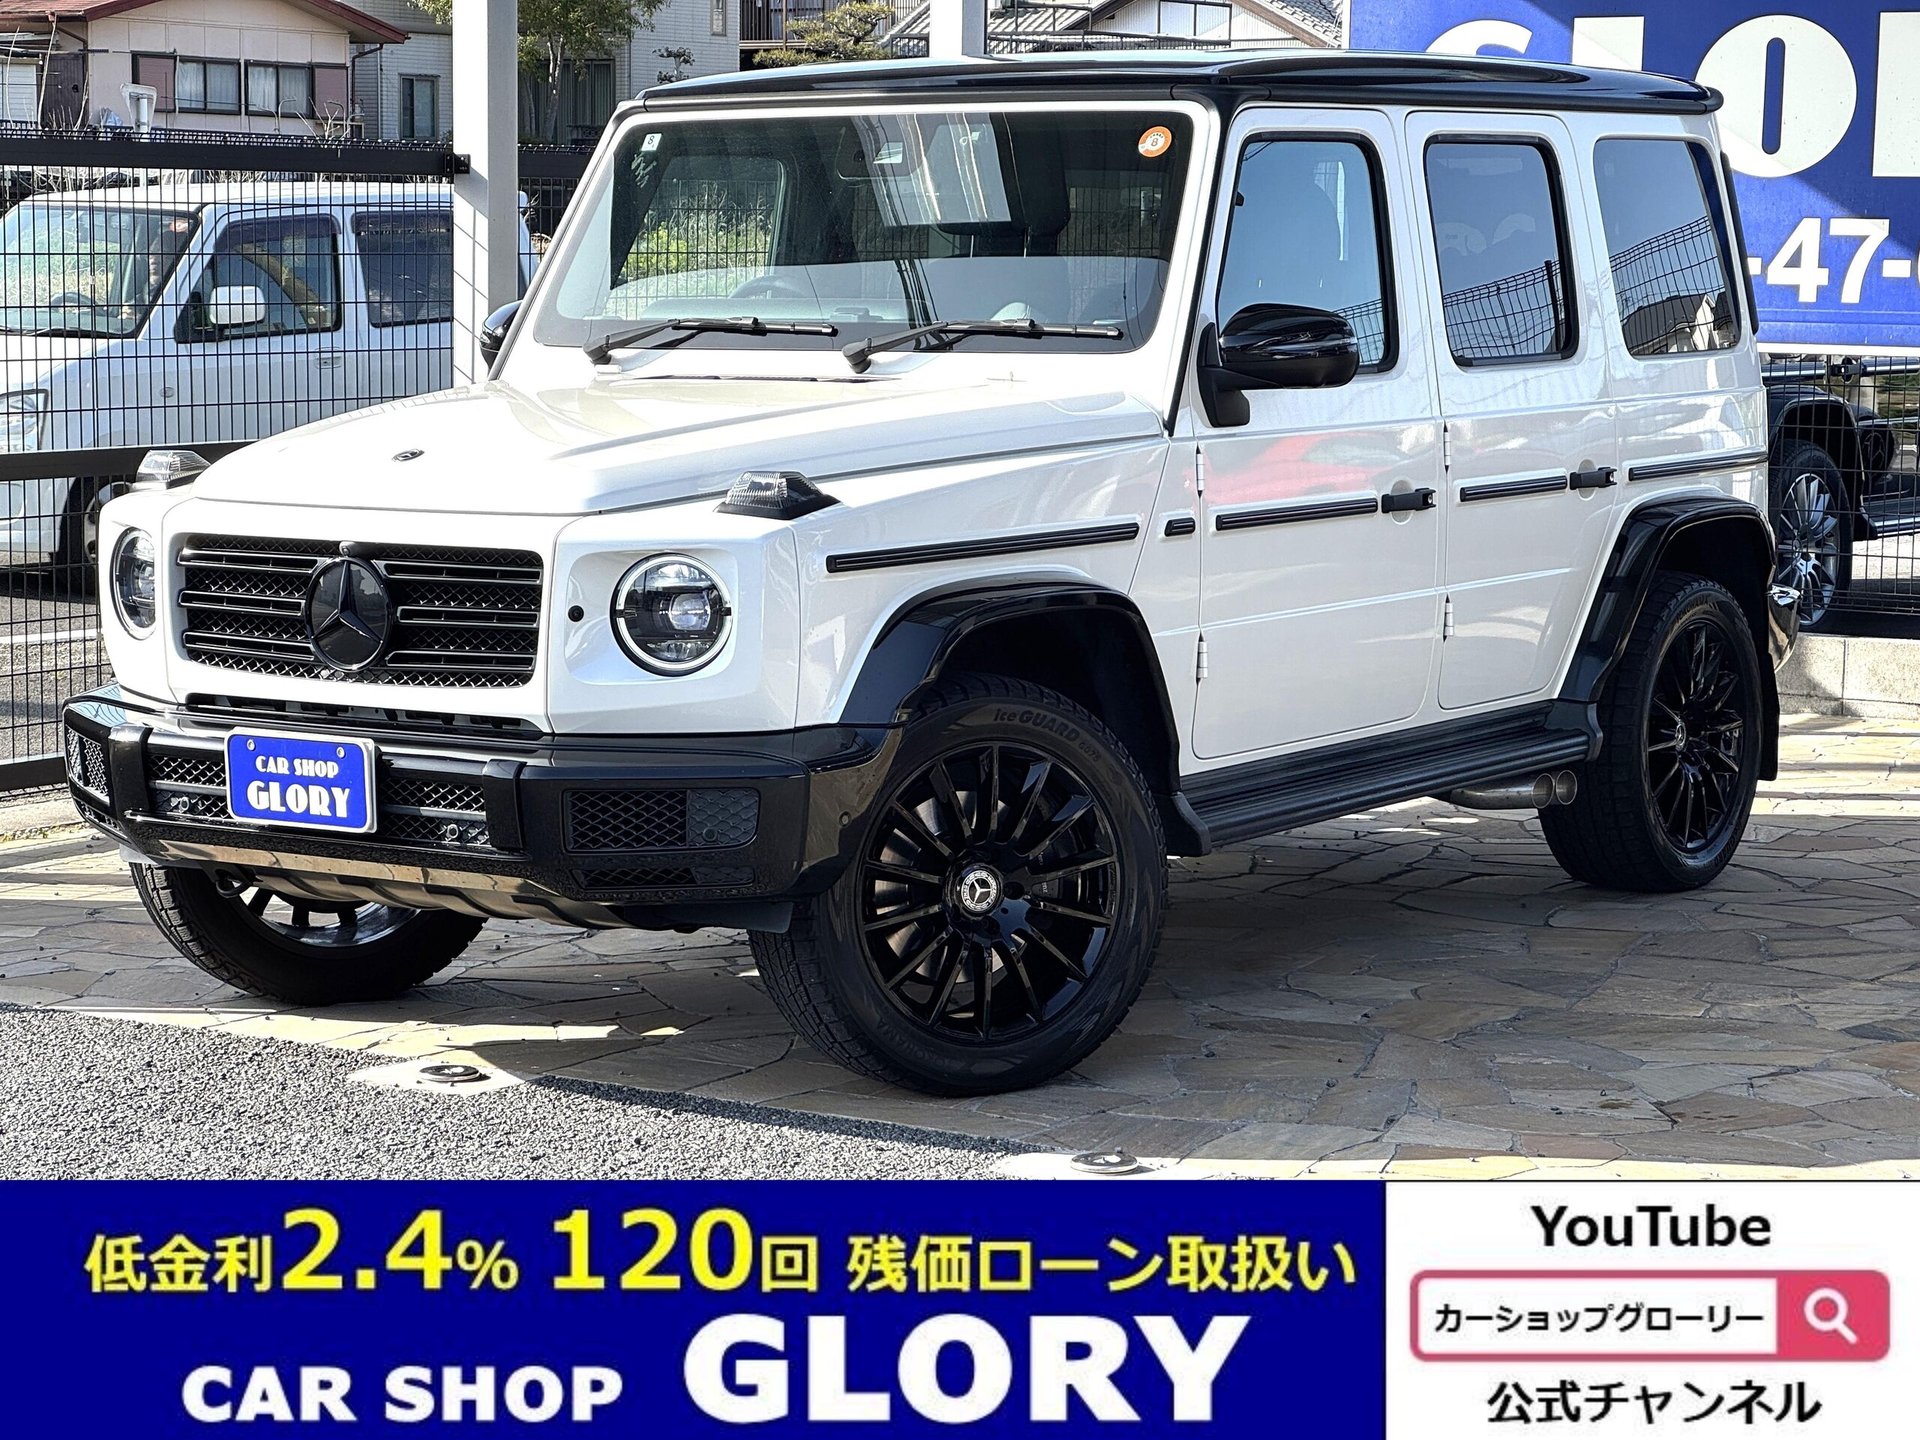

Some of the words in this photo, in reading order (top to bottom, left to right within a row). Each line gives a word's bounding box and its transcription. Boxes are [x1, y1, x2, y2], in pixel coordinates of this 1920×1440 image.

[1748, 217, 1920, 304] -47-
[255, 755, 291, 775] CAR
[294, 758, 339, 779] SHOP
[246, 780, 350, 818] GLORY
